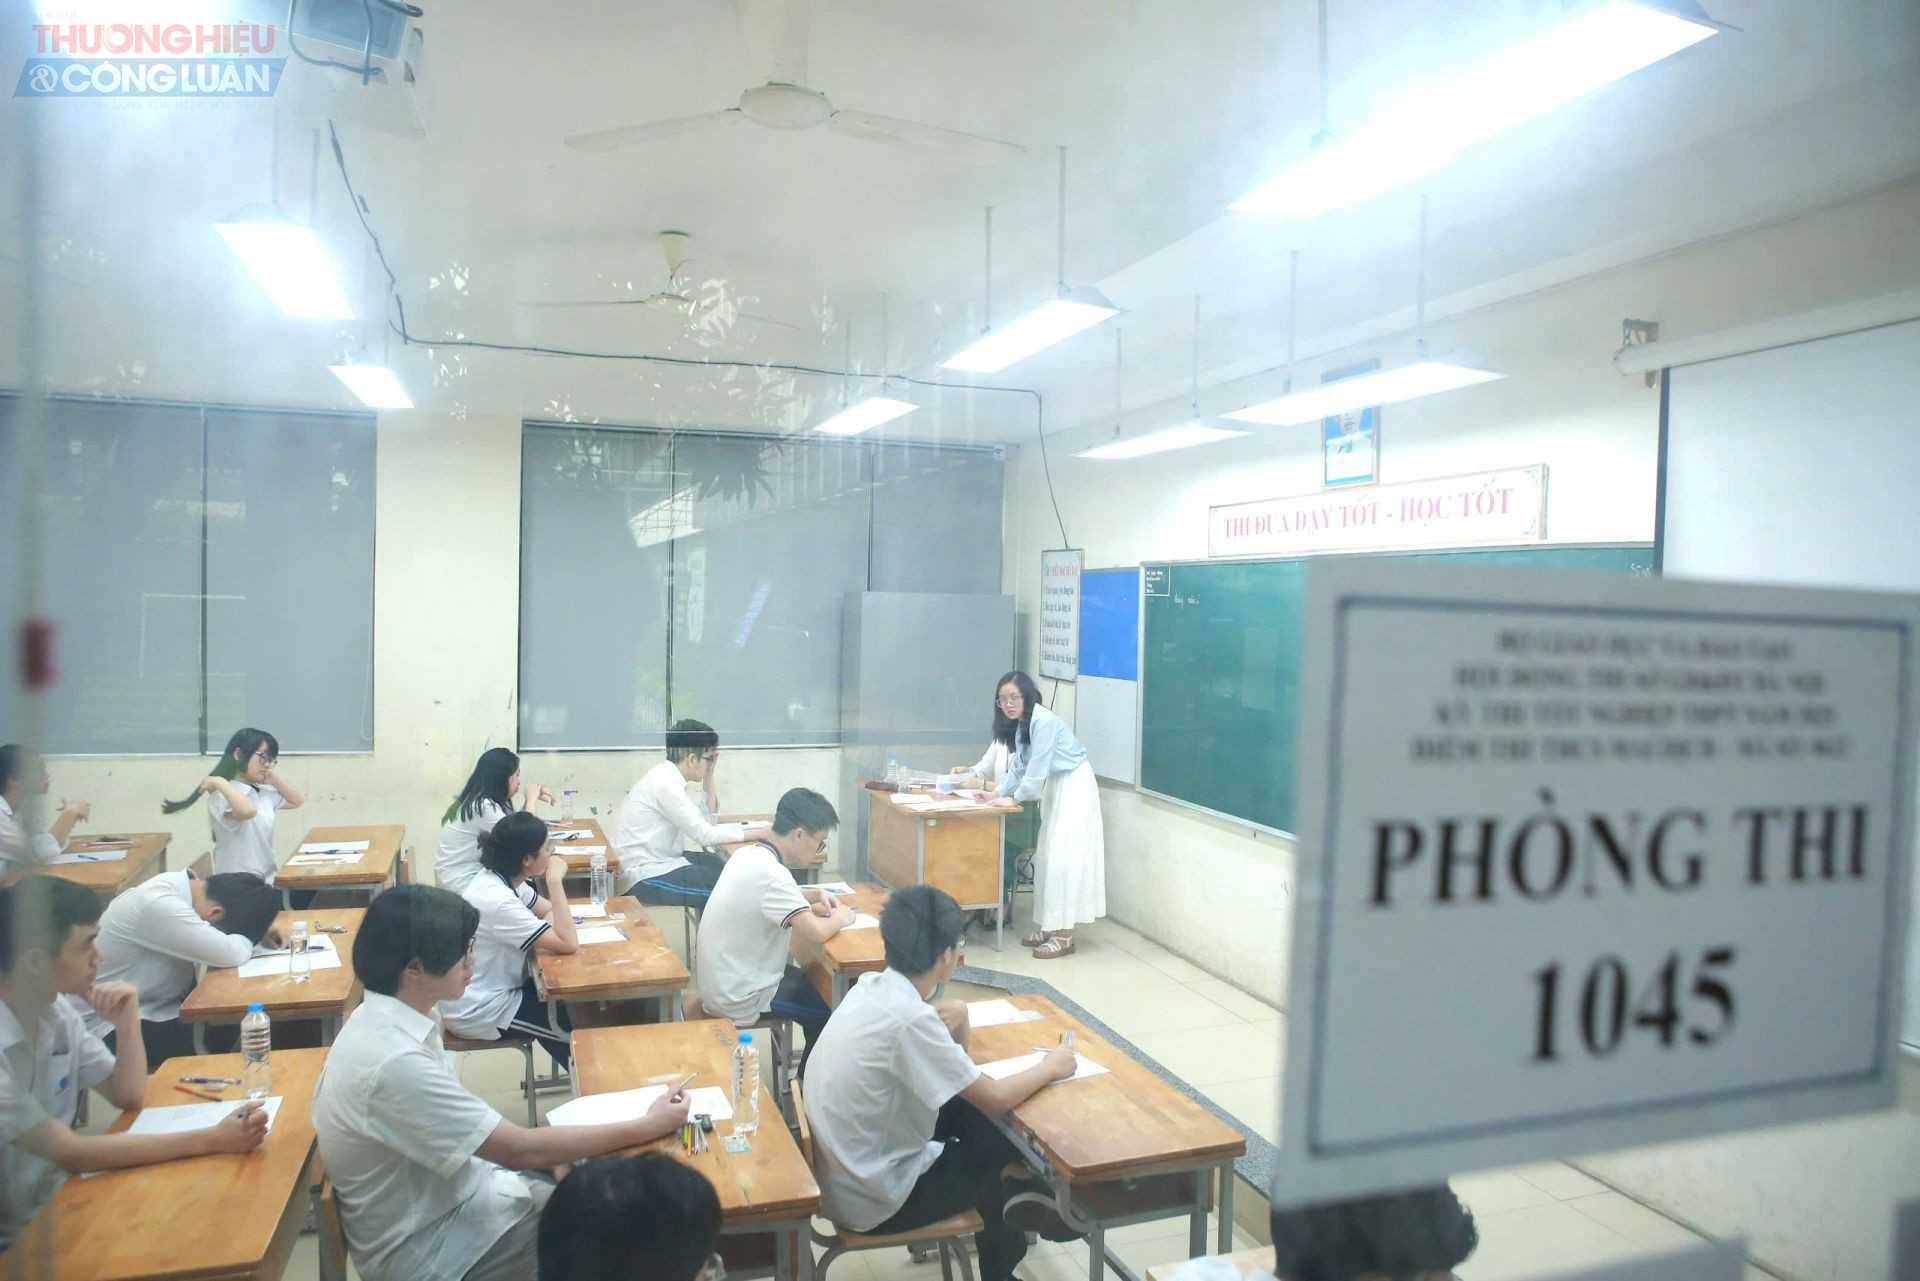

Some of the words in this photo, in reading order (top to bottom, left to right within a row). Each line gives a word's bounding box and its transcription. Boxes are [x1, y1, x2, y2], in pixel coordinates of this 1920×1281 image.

[1224, 516, 1250, 537] THI
[1254, 514, 1289, 535] ĐUA
[1295, 507, 1332, 535] DẠY
[1339, 494, 1380, 527] TỐT
[1400, 495, 1451, 527] HỌC
[1459, 478, 1514, 517] TỐT
[1368, 787, 1706, 908] PHÒNG
[1734, 804, 1868, 885] THI
[1529, 944, 1739, 1065] 1045
